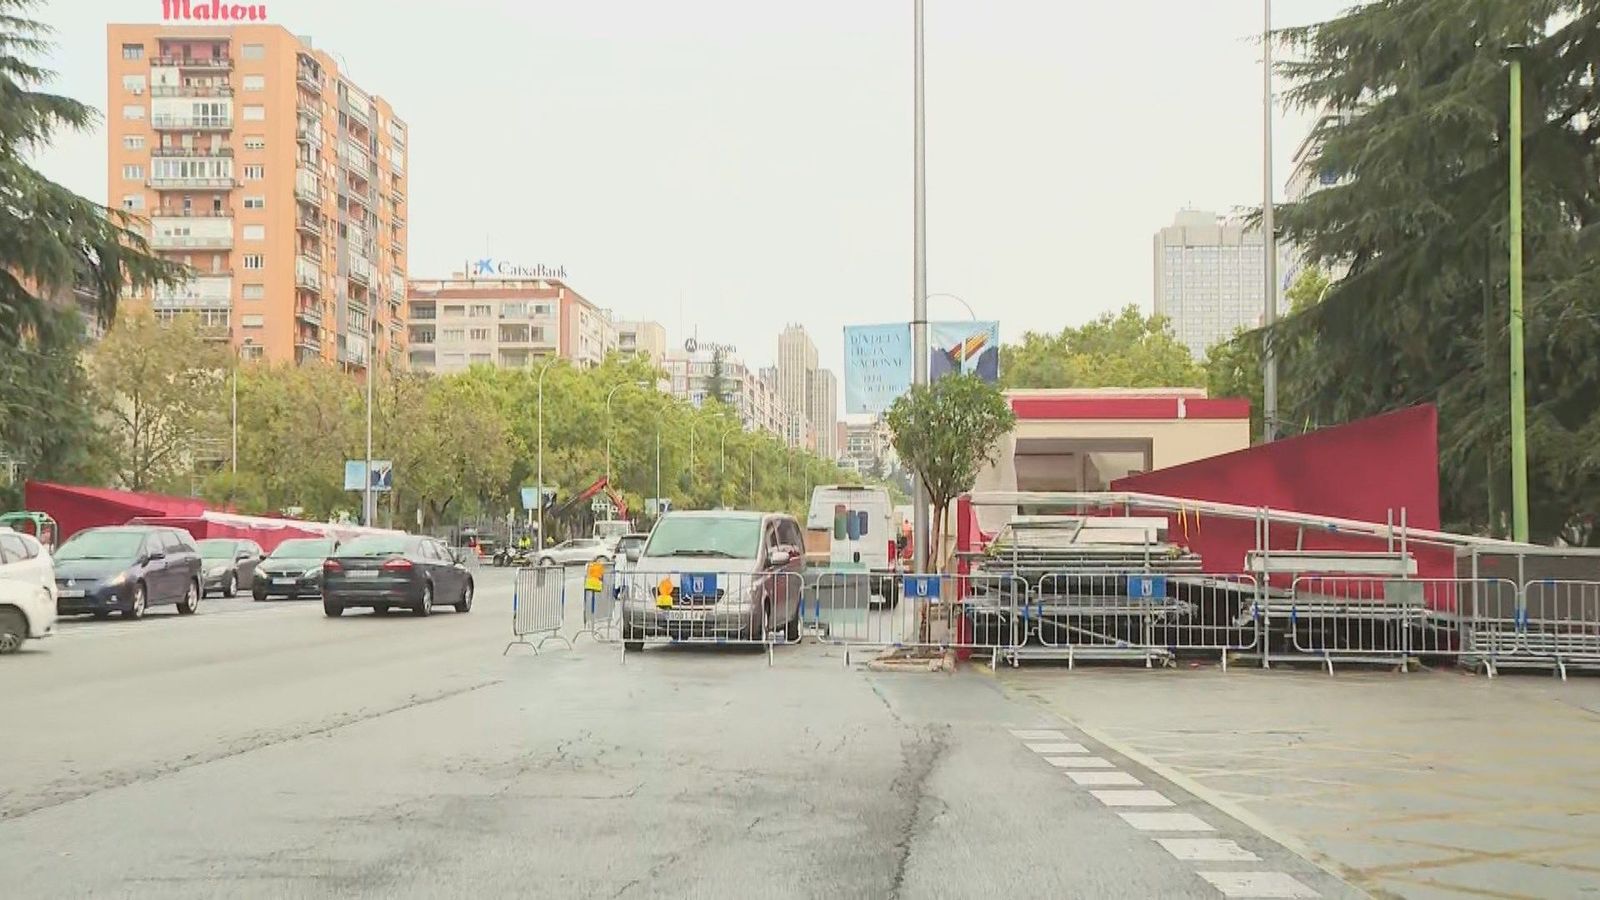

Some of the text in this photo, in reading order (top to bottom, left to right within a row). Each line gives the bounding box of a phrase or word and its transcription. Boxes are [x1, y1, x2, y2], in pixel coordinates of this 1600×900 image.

[162, 0, 267, 20] Mahou
[498, 261, 568, 278] CaixaBank
[852, 358, 904, 368] NACIONAL
